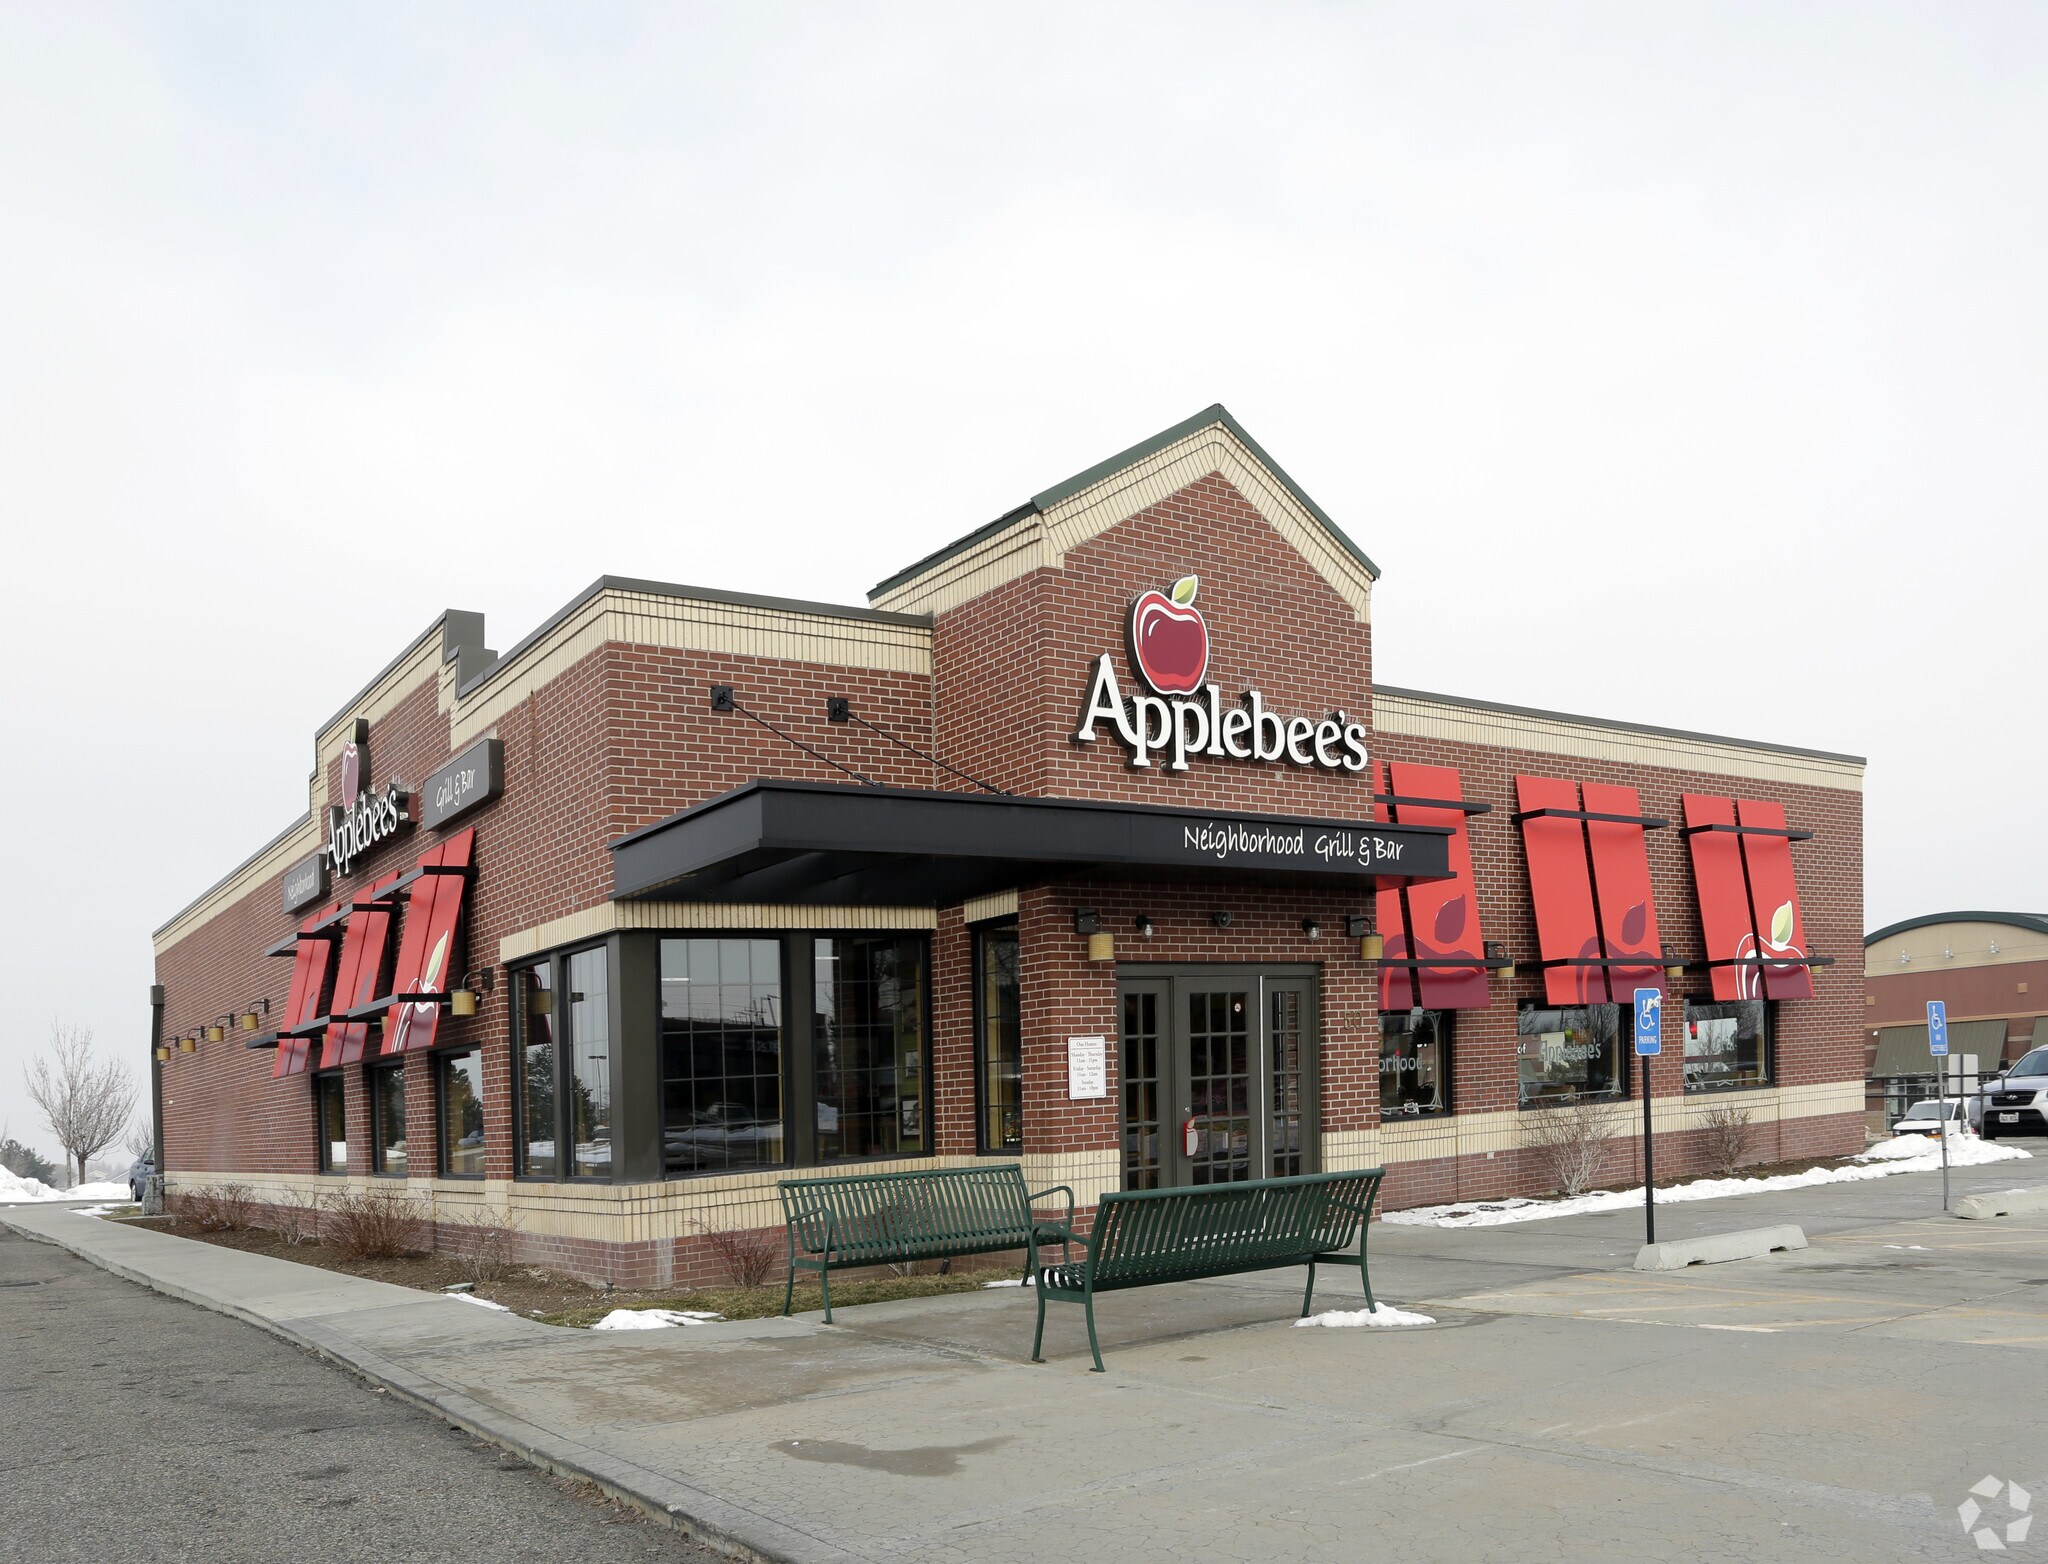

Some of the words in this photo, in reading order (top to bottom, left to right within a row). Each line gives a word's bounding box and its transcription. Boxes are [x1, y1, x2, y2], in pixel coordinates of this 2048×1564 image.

[1076, 652, 1369, 771] Applebee's
[436, 777, 453, 814] Grill
[461, 769, 475, 794] Bar
[326, 783, 397, 878] Applebee's
[1184, 822, 1304, 859] Neighborhood
[1314, 831, 1354, 863] Grill
[1358, 836, 1370, 866] &
[1373, 837, 1404, 861] Bar
[1638, 1036, 1657, 1044] PARKING
[1378, 1053, 1422, 1072] orhood
